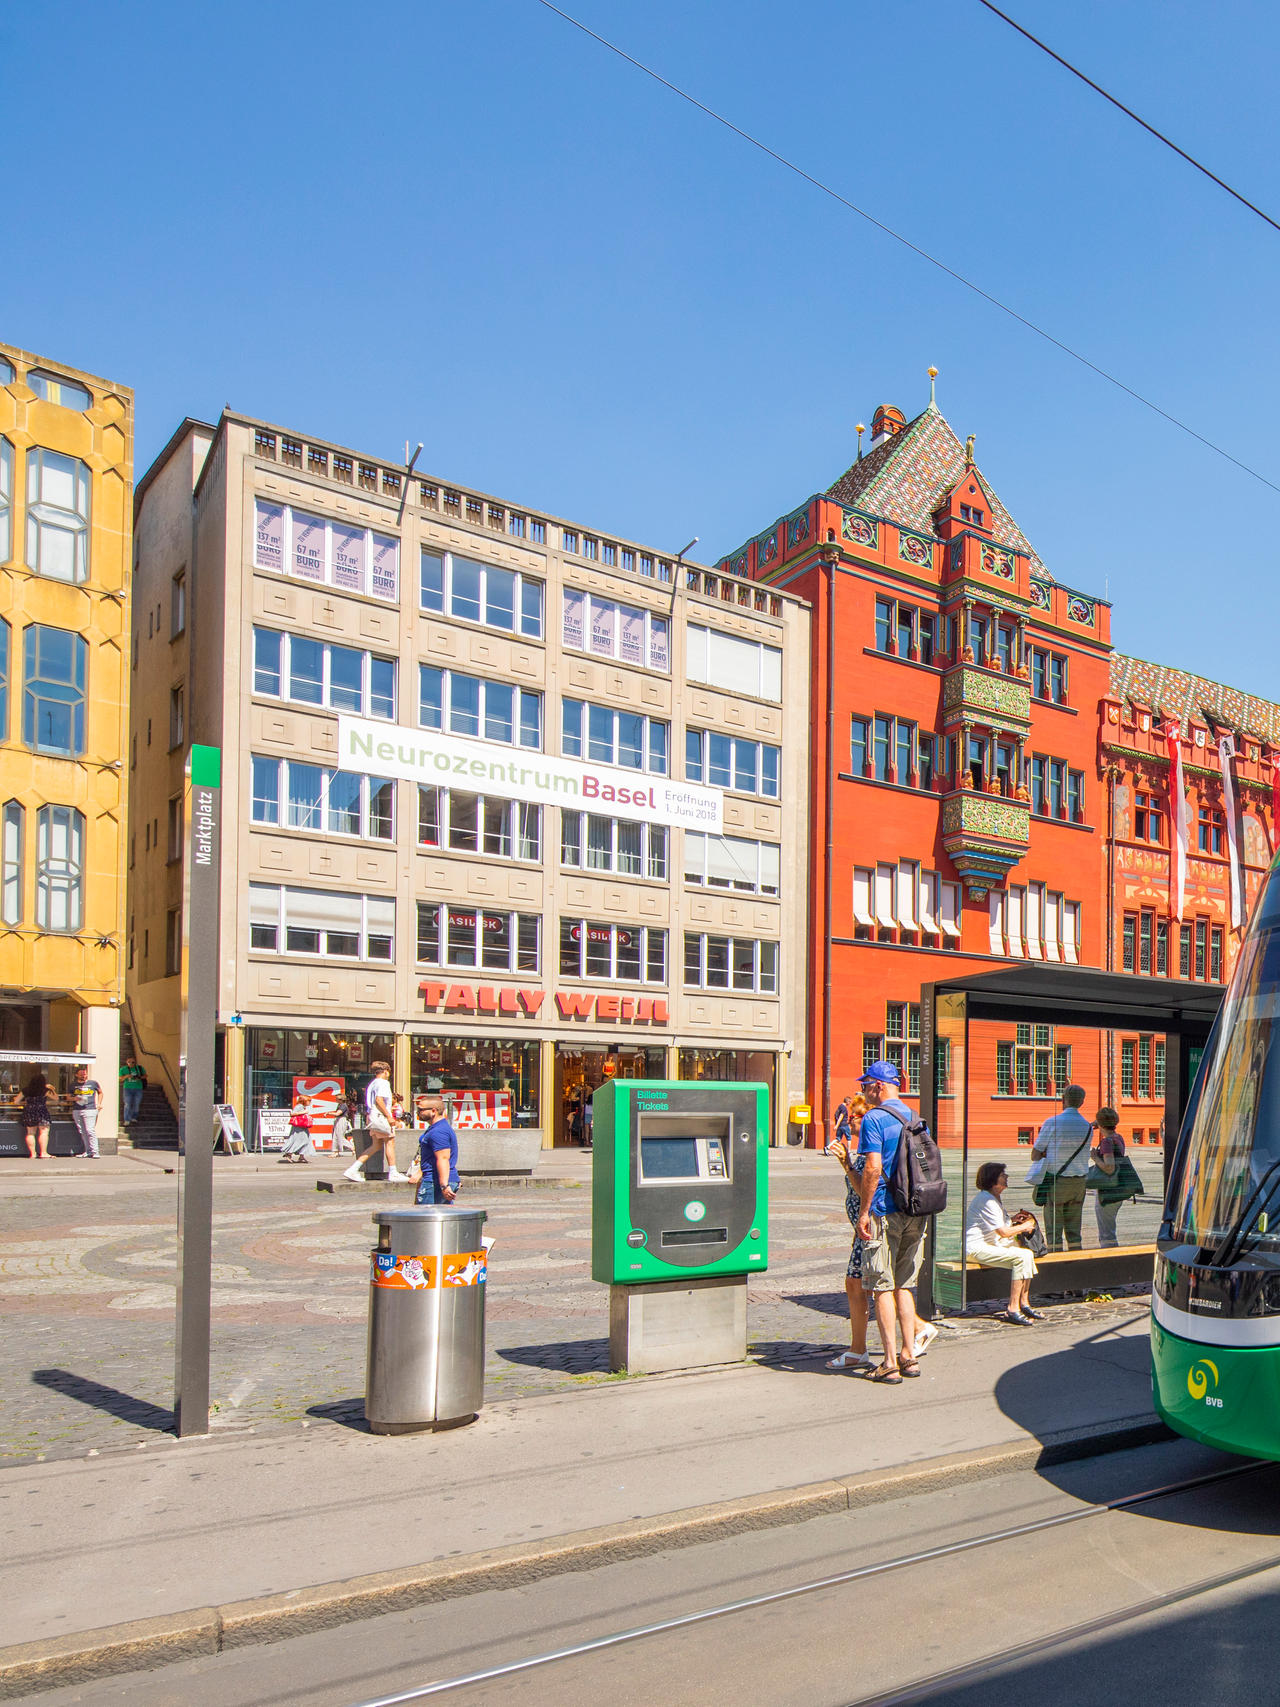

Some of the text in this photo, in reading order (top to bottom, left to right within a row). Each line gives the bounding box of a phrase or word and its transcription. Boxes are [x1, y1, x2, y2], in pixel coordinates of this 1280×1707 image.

[257, 531, 269, 541] 137
[296, 544, 306, 554] 67
[336, 553, 347, 562] 137
[373, 565, 382, 574] 67
[593, 625, 601, 634] 67
[675, 805, 694, 817] Juni
[696, 809, 717, 821] 2018
[195, 791, 216, 865] Marktplatz
[448, 916, 498, 929] ASILSK
[419, 981, 546, 1013] TALLY
[922, 998, 931, 1066] Marktplatz
[637, 1091, 668, 1100] Billette
[637, 1102, 669, 1111] Tickets
[378, 1257, 394, 1267] Da!
[1205, 1396, 1224, 1408] BVB
